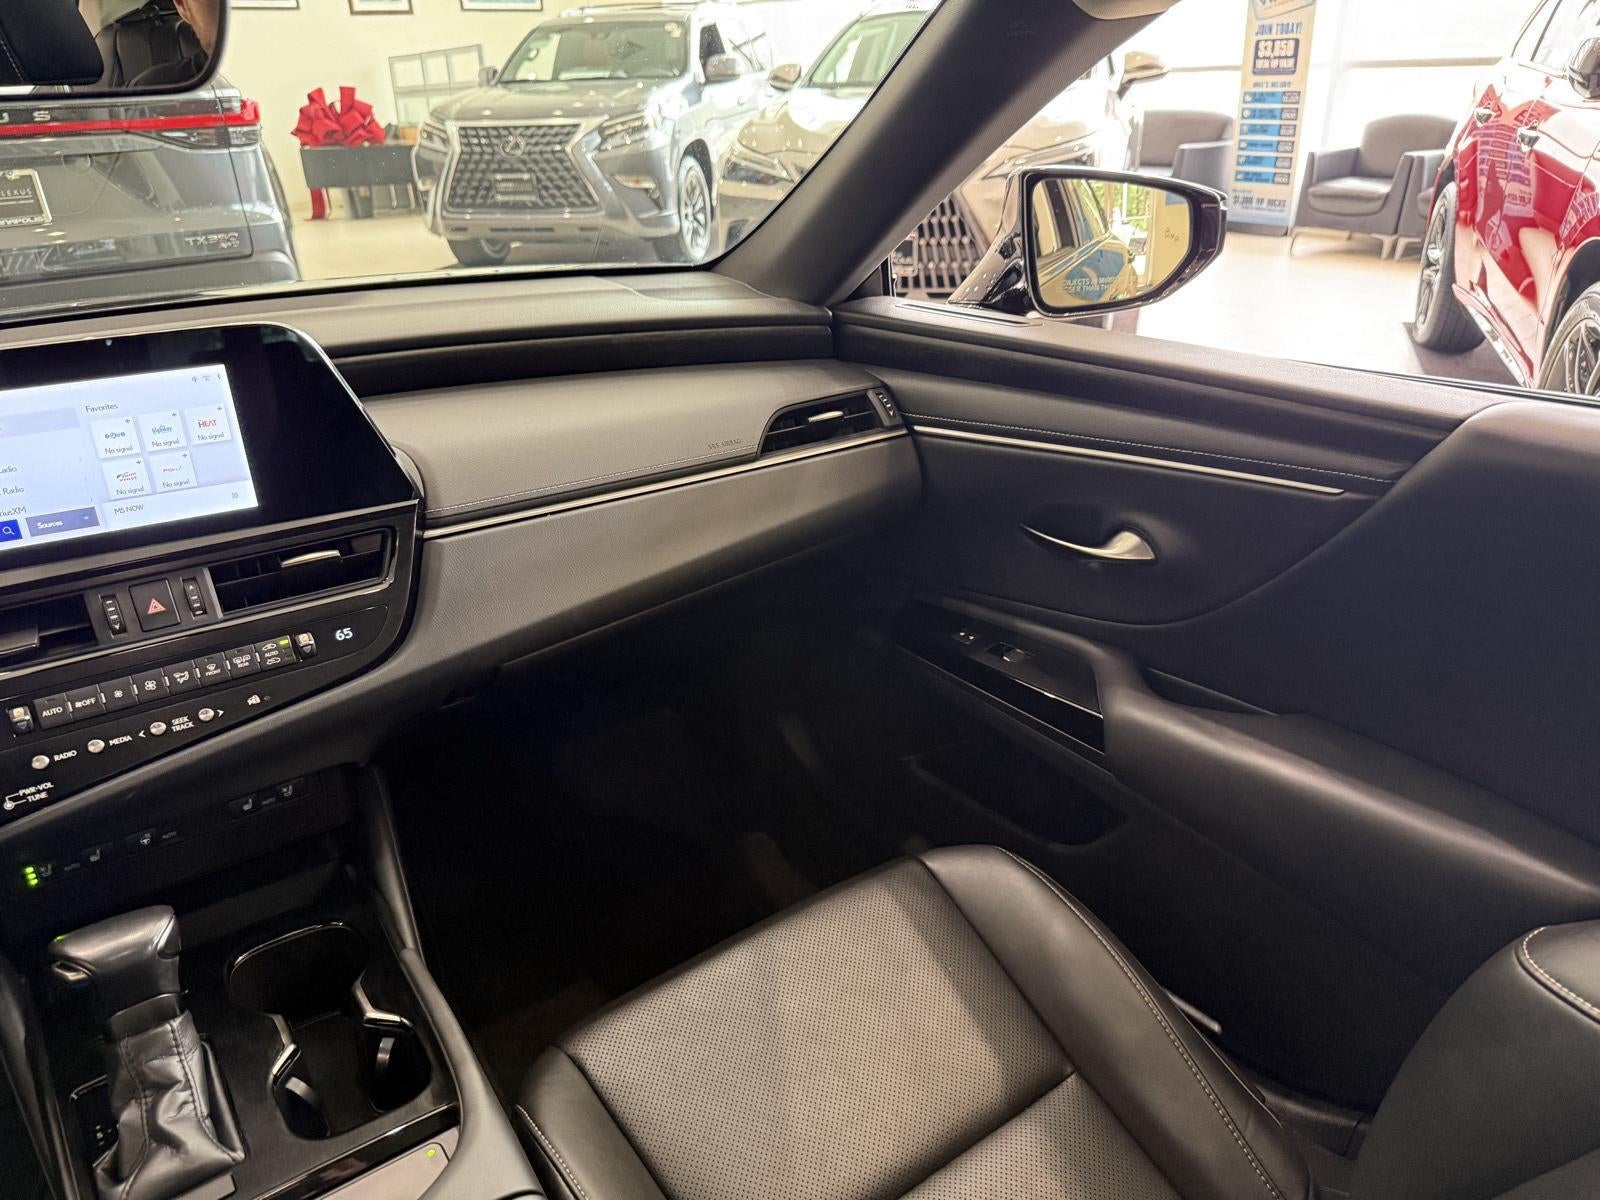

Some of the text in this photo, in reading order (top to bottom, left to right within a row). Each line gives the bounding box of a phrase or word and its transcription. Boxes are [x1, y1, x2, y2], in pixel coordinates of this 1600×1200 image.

[85, 403, 118, 413] Favorites
[209, 432, 225, 441] signal
[162, 438, 180, 447] signal
[105, 445, 133, 455] No signal
[163, 478, 190, 489] No signal
[3, 486, 25, 495] Radio
[127, 486, 145, 495] signal
[114, 504, 144, 515] MS NOW
[37, 520, 64, 529] Sources
[335, 628, 354, 641] 65
[42, 697, 97, 718] AUTO OFF
[171, 716, 190, 726] SEEK
[171, 721, 195, 732] TRACK
[109, 735, 133, 747] MEDIA
[53, 750, 78, 762] RADIO
[26, 792, 49, 802] TUNE
